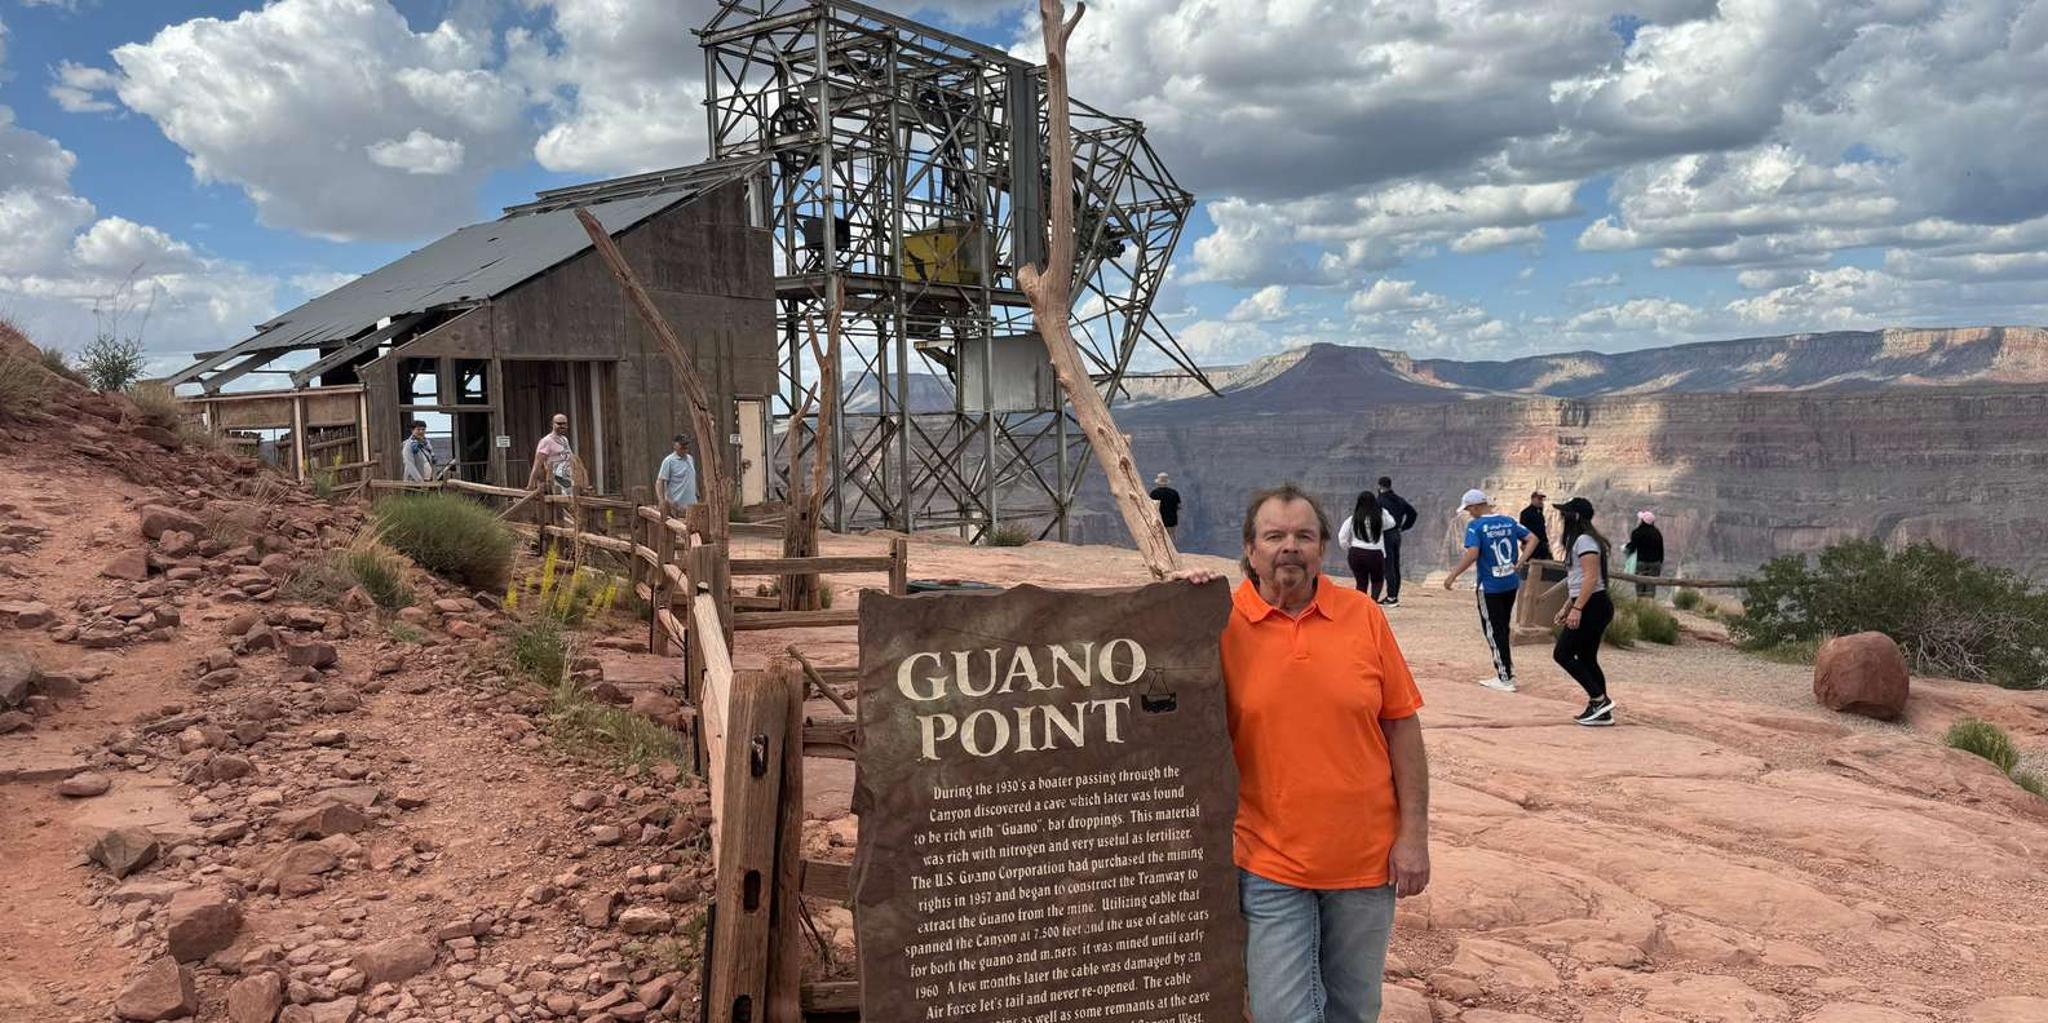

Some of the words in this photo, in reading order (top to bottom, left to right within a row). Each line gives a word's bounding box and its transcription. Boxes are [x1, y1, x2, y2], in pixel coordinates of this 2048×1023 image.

[1489, 537, 1513, 566] 10
[897, 638, 1147, 701] GUANO
[916, 696, 1132, 762] POINT
[929, 807, 972, 823] Canyon
[973, 799, 1032, 818] discovered
[1034, 801, 1042, 812] a
[1043, 798, 1067, 811] cave
[1068, 792, 1101, 807] which
[1103, 791, 1129, 805] later
[1131, 790, 1152, 802] was
[1153, 784, 1185, 801] found
[933, 784, 973, 800] During
[975, 782, 993, 796] the
[996, 778, 1027, 794] 1930's
[1028, 780, 1036, 791] a
[1038, 776, 1073, 790] boater
[1075, 770, 1117, 789] passing
[1118, 765, 1161, 782] through
[1163, 764, 1180, 779] the
[913, 833, 926, 846] to
[928, 830, 942, 844] be
[944, 827, 966, 843] rich
[968, 824, 994, 840] with
[1047, 818, 1066, 832] bat
[1067, 813, 1125, 831] droppings.
[1129, 809, 1153, 824] This
[1155, 803, 1200, 821] material
[910, 875, 932, 890] The
[959, 870, 997, 885] Guano
[998, 861, 1066, 881] Corporation
[1067, 857, 1089, 873] had
[1091, 851, 1145, 874] purchased
[1147, 850, 1164, 864] the
[1167, 847, 1204, 862] mining
[922, 854, 945, 867] was
[946, 848, 969, 864] rich
[971, 845, 997, 861] with
[999, 843, 1046, 858] nitrogen
[1048, 837, 1070, 853] and
[1071, 837, 1095, 851] very
[1096, 831, 1129, 848] useful
[1131, 833, 1144, 845] as
[1146, 827, 1193, 843] fertilizer.
[917, 918, 956, 934] extract
[958, 914, 977, 929] the
[978, 911, 1016, 926] Guano
[1017, 907, 1045, 922] from
[1047, 903, 1065, 917] the
[1066, 900, 1097, 915] mine.
[1101, 895, 1148, 912] Utilizing
[1149, 890, 1177, 906] cable
[1178, 888, 1200, 902] that
[918, 896, 952, 914] rights
[954, 893, 966, 907] in
[969, 891, 992, 906] 1957
[994, 887, 1017, 903] and
[1018, 885, 1052, 902] began
[1053, 884, 1066, 896] to
[1067, 877, 1117, 895] construct
[1119, 874, 1136, 888] the
[1137, 870, 1186, 885] Tramway
[1187, 868, 1199, 881] to
[904, 937, 953, 959] spanned
[955, 936, 974, 950] the
[975, 933, 1018, 948] Canyon
[1020, 930, 1031, 942] at
[1062, 923, 1082, 937] feet
[1083, 919, 1104, 934] and
[1106, 918, 1124, 931] the
[1125, 917, 1144, 929] use
[1145, 911, 1157, 926] of
[1158, 910, 1186, 925] cable
[1187, 909, 1210, 922] cars
[910, 963, 928, 978] for
[929, 959, 956, 975] both
[958, 957, 977, 972] the
[978, 954, 1014, 972] guano
[1016, 948, 1038, 964] and
[1082, 942, 1091, 955] it
[1092, 941, 1114, 953] was
[1115, 934, 1149, 951] mined
[1151, 931, 1177, 947] until
[1178, 928, 1205, 943] early
[925, 1004, 944, 1019] Air
[946, 1002, 977, 1016] Force
[979, 996, 1003, 1012] Jet's
[1005, 992, 1024, 1009] tail
[1026, 989, 1048, 1005] and
[1049, 987, 1080, 1002] never
[1081, 978, 1138, 998] re-opened.
[1142, 975, 1163, 990] The
[1164, 971, 1192, 987] cable
[946, 980, 956, 995] A
[957, 979, 977, 993] few
[979, 973, 1022, 991] months
[1024, 970, 1050, 985] later
[1052, 966, 1069, 980] the
[1070, 962, 1100, 978] cable
[1101, 961, 1122, 973] was
[1123, 952, 1172, 971] damaged
[1173, 951, 1186, 967] by
[1187, 951, 1202, 963] an
[1034, 1009, 1058, 1023] well
[1060, 1010, 1072, 1022] as
[1074, 1006, 1103, 1020] some
[1104, 999, 1156, 1016] remnants
[1156, 997, 1168, 1009] at
[1170, 993, 1187, 1008] the
[1188, 991, 1211, 1004] cave
